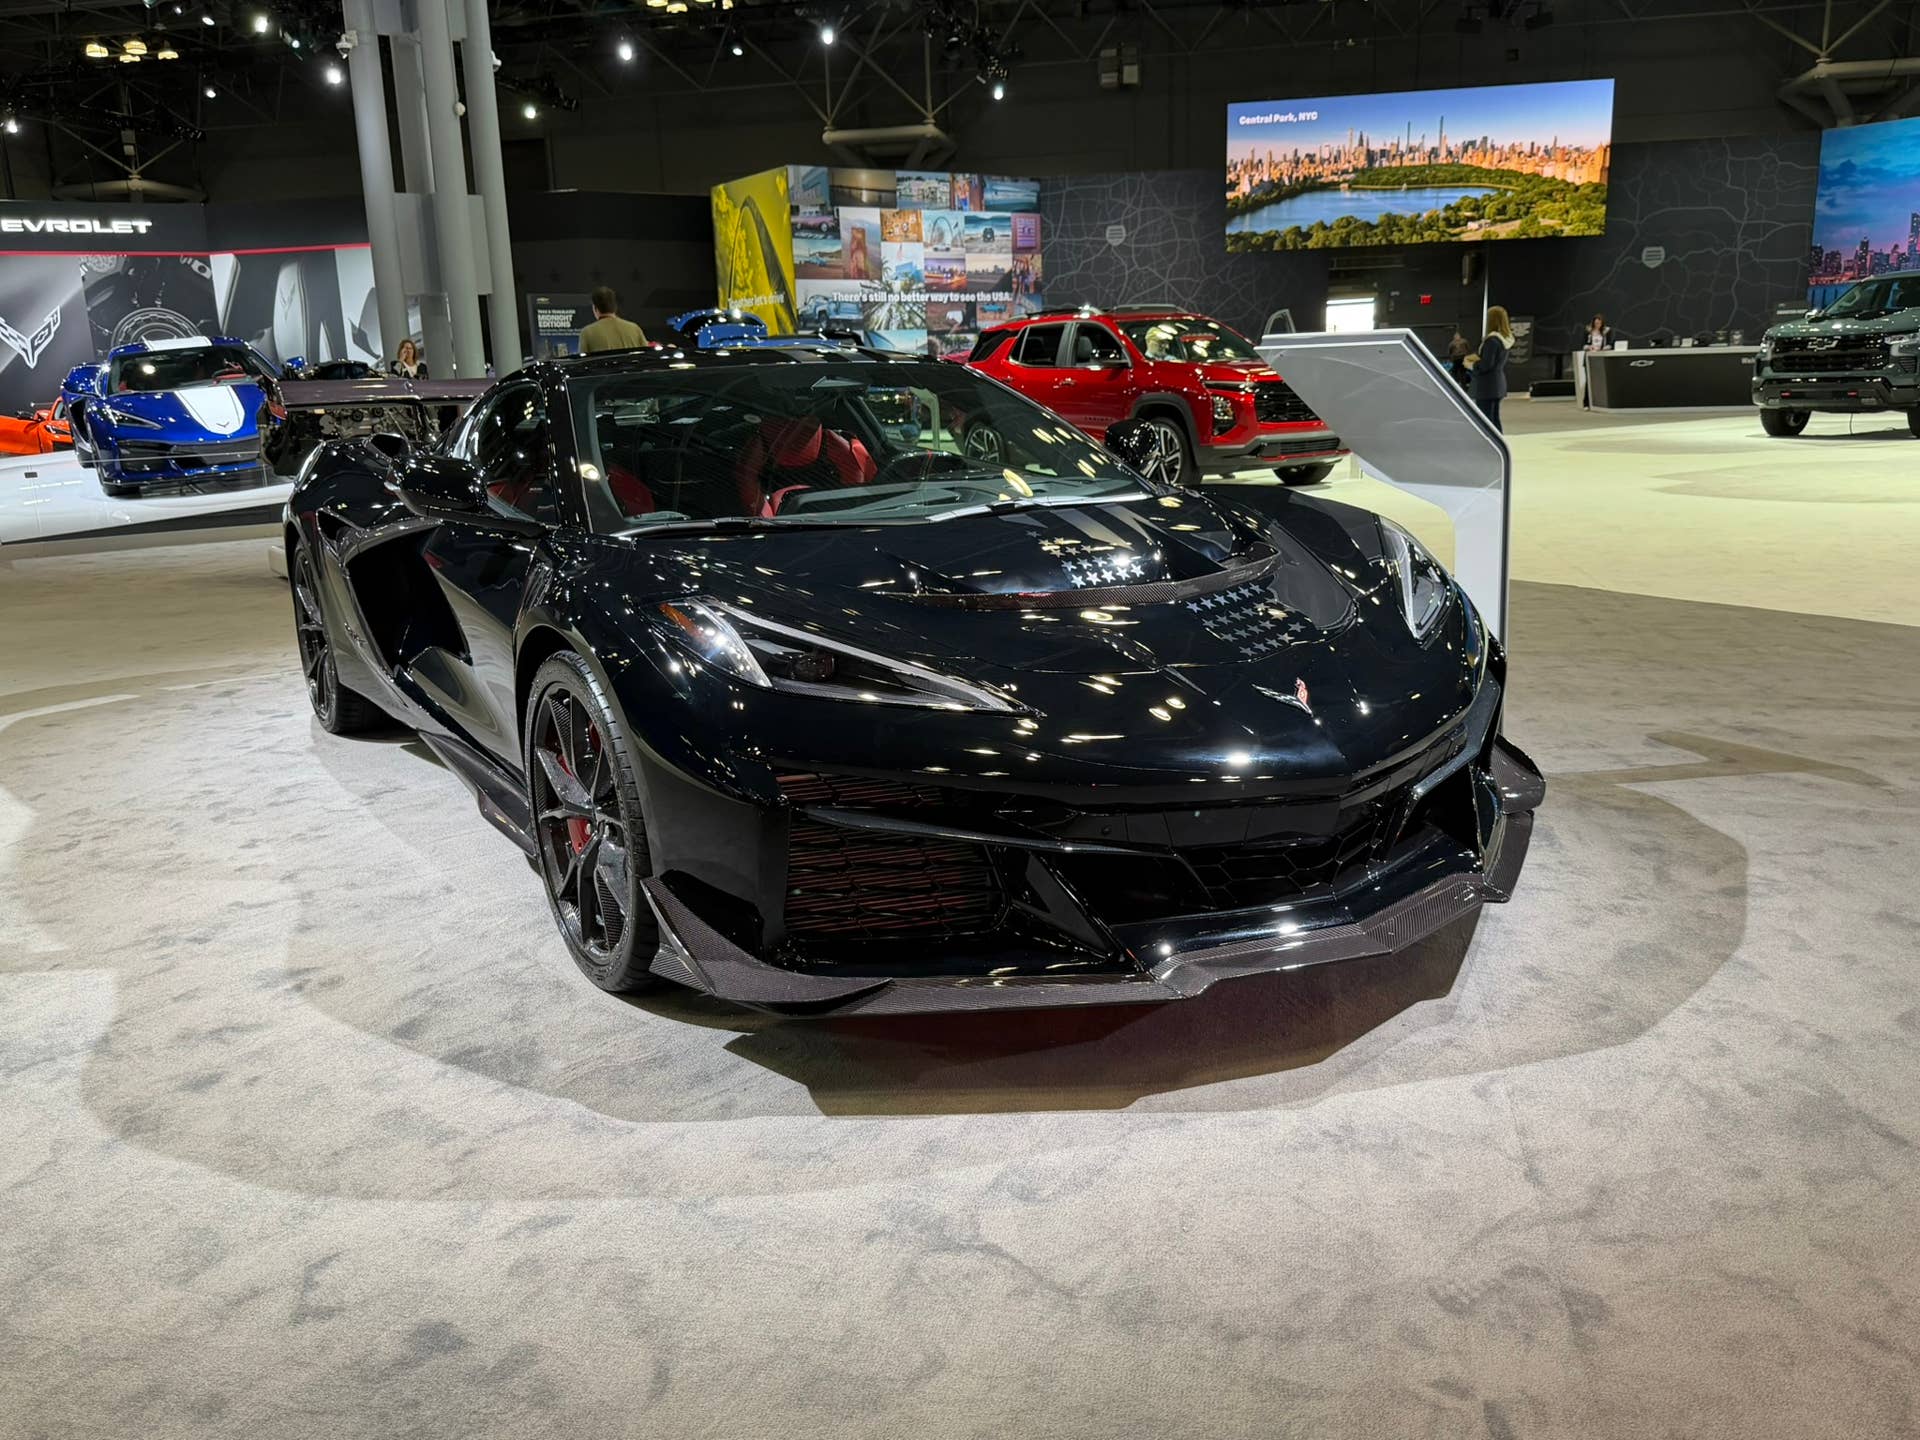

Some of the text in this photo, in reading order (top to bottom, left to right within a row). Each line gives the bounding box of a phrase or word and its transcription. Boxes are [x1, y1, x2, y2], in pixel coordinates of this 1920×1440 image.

[1239, 111, 1319, 126] Central Park, NYC
[832, 291, 1013, 305] There's still no better way to see the USA.
[537, 314, 573, 322] MIDNIGHT
[538, 321, 571, 329] EDITIONS
